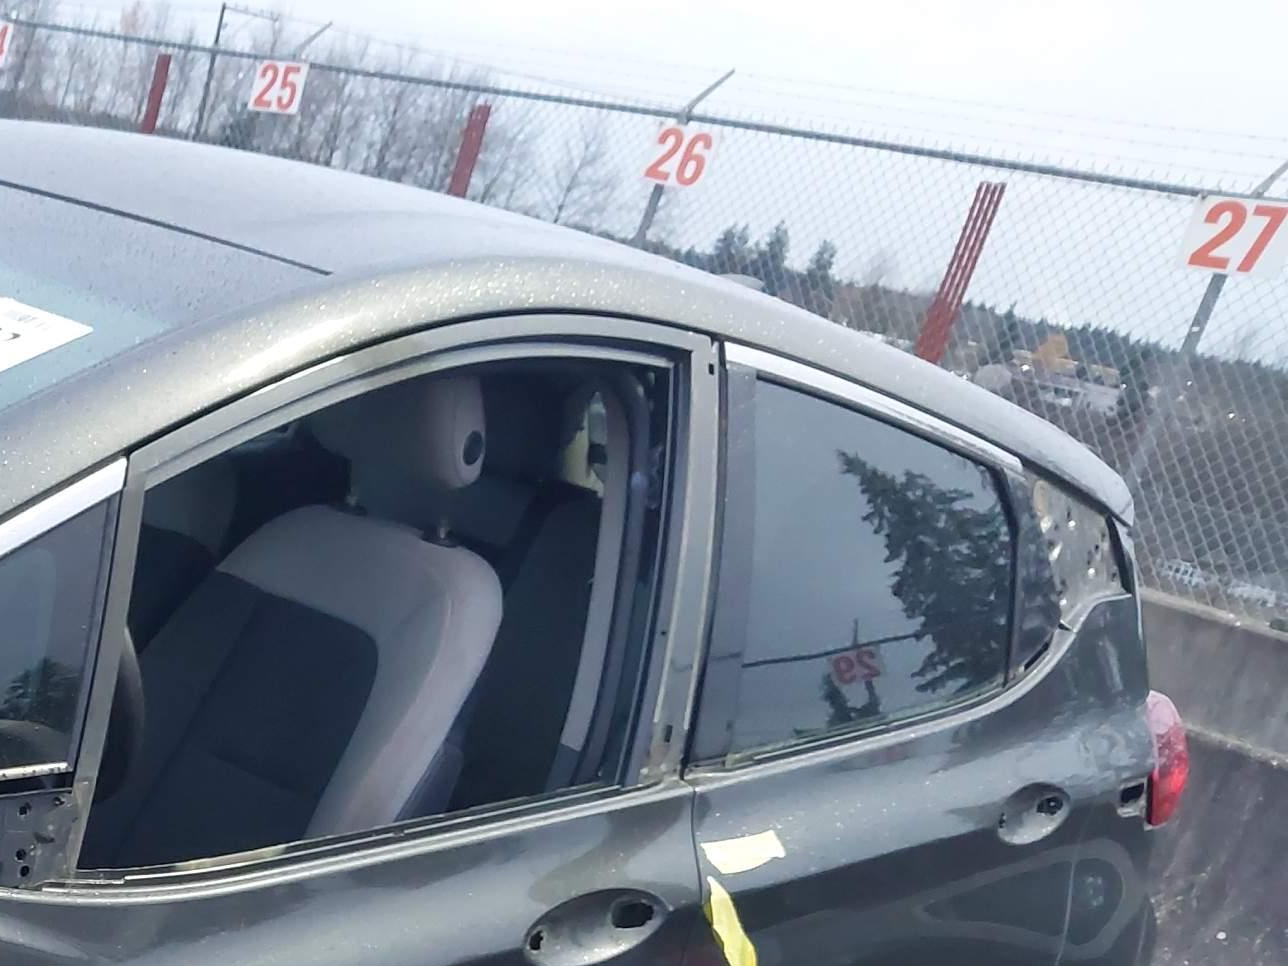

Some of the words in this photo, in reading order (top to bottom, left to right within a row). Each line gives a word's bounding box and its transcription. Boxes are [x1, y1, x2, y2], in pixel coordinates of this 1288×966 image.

[253, 62, 302, 111] 25
[644, 127, 713, 187] 26
[1187, 199, 1288, 273] 27
